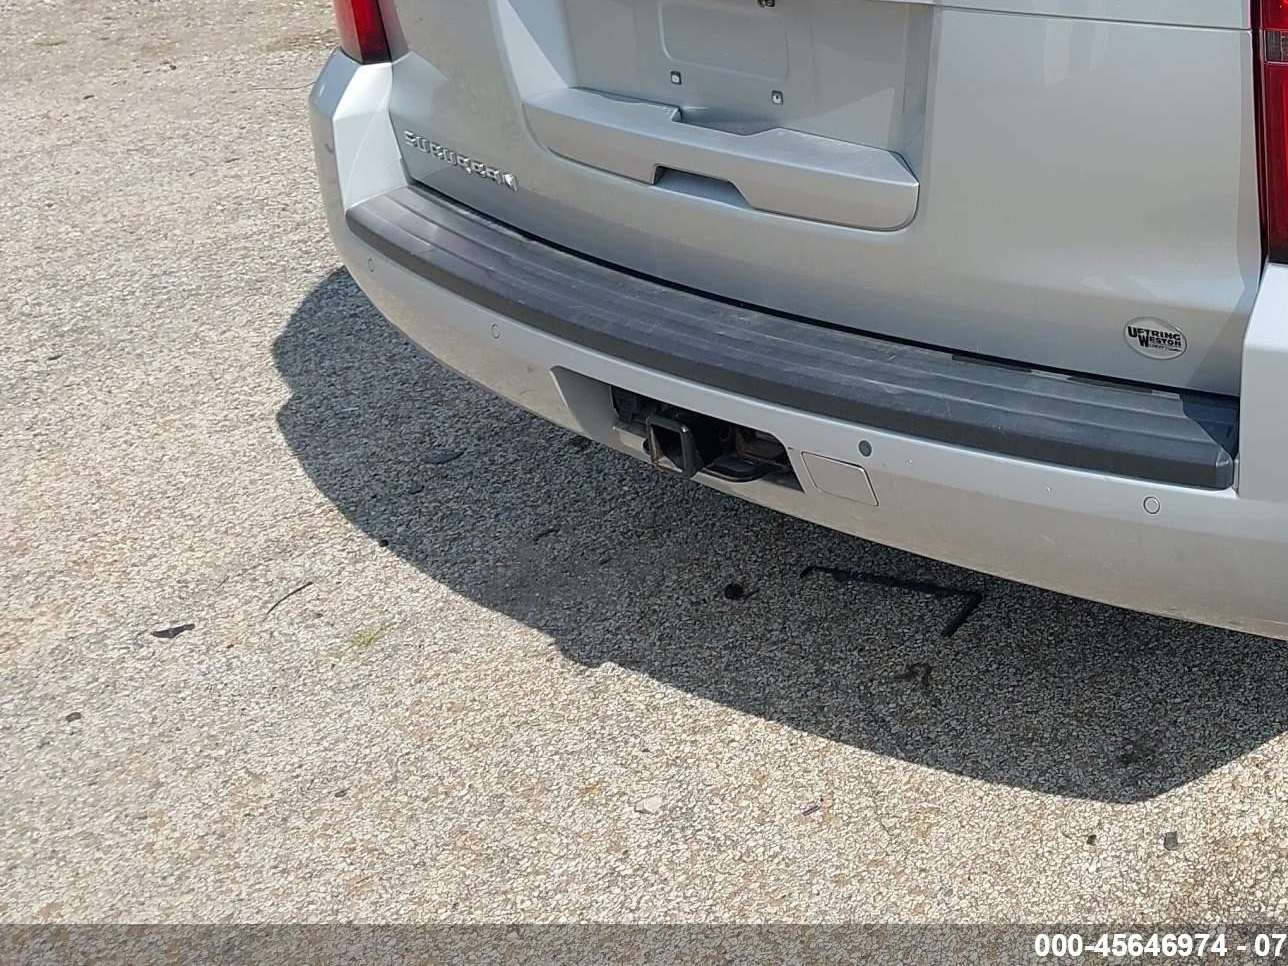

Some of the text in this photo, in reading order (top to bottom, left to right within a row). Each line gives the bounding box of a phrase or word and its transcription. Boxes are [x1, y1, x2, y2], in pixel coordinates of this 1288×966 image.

[403, 130, 518, 192] SUBURBAN
[1127, 326, 1181, 341] UFTRING
[1138, 335, 1182, 347] WESTON
